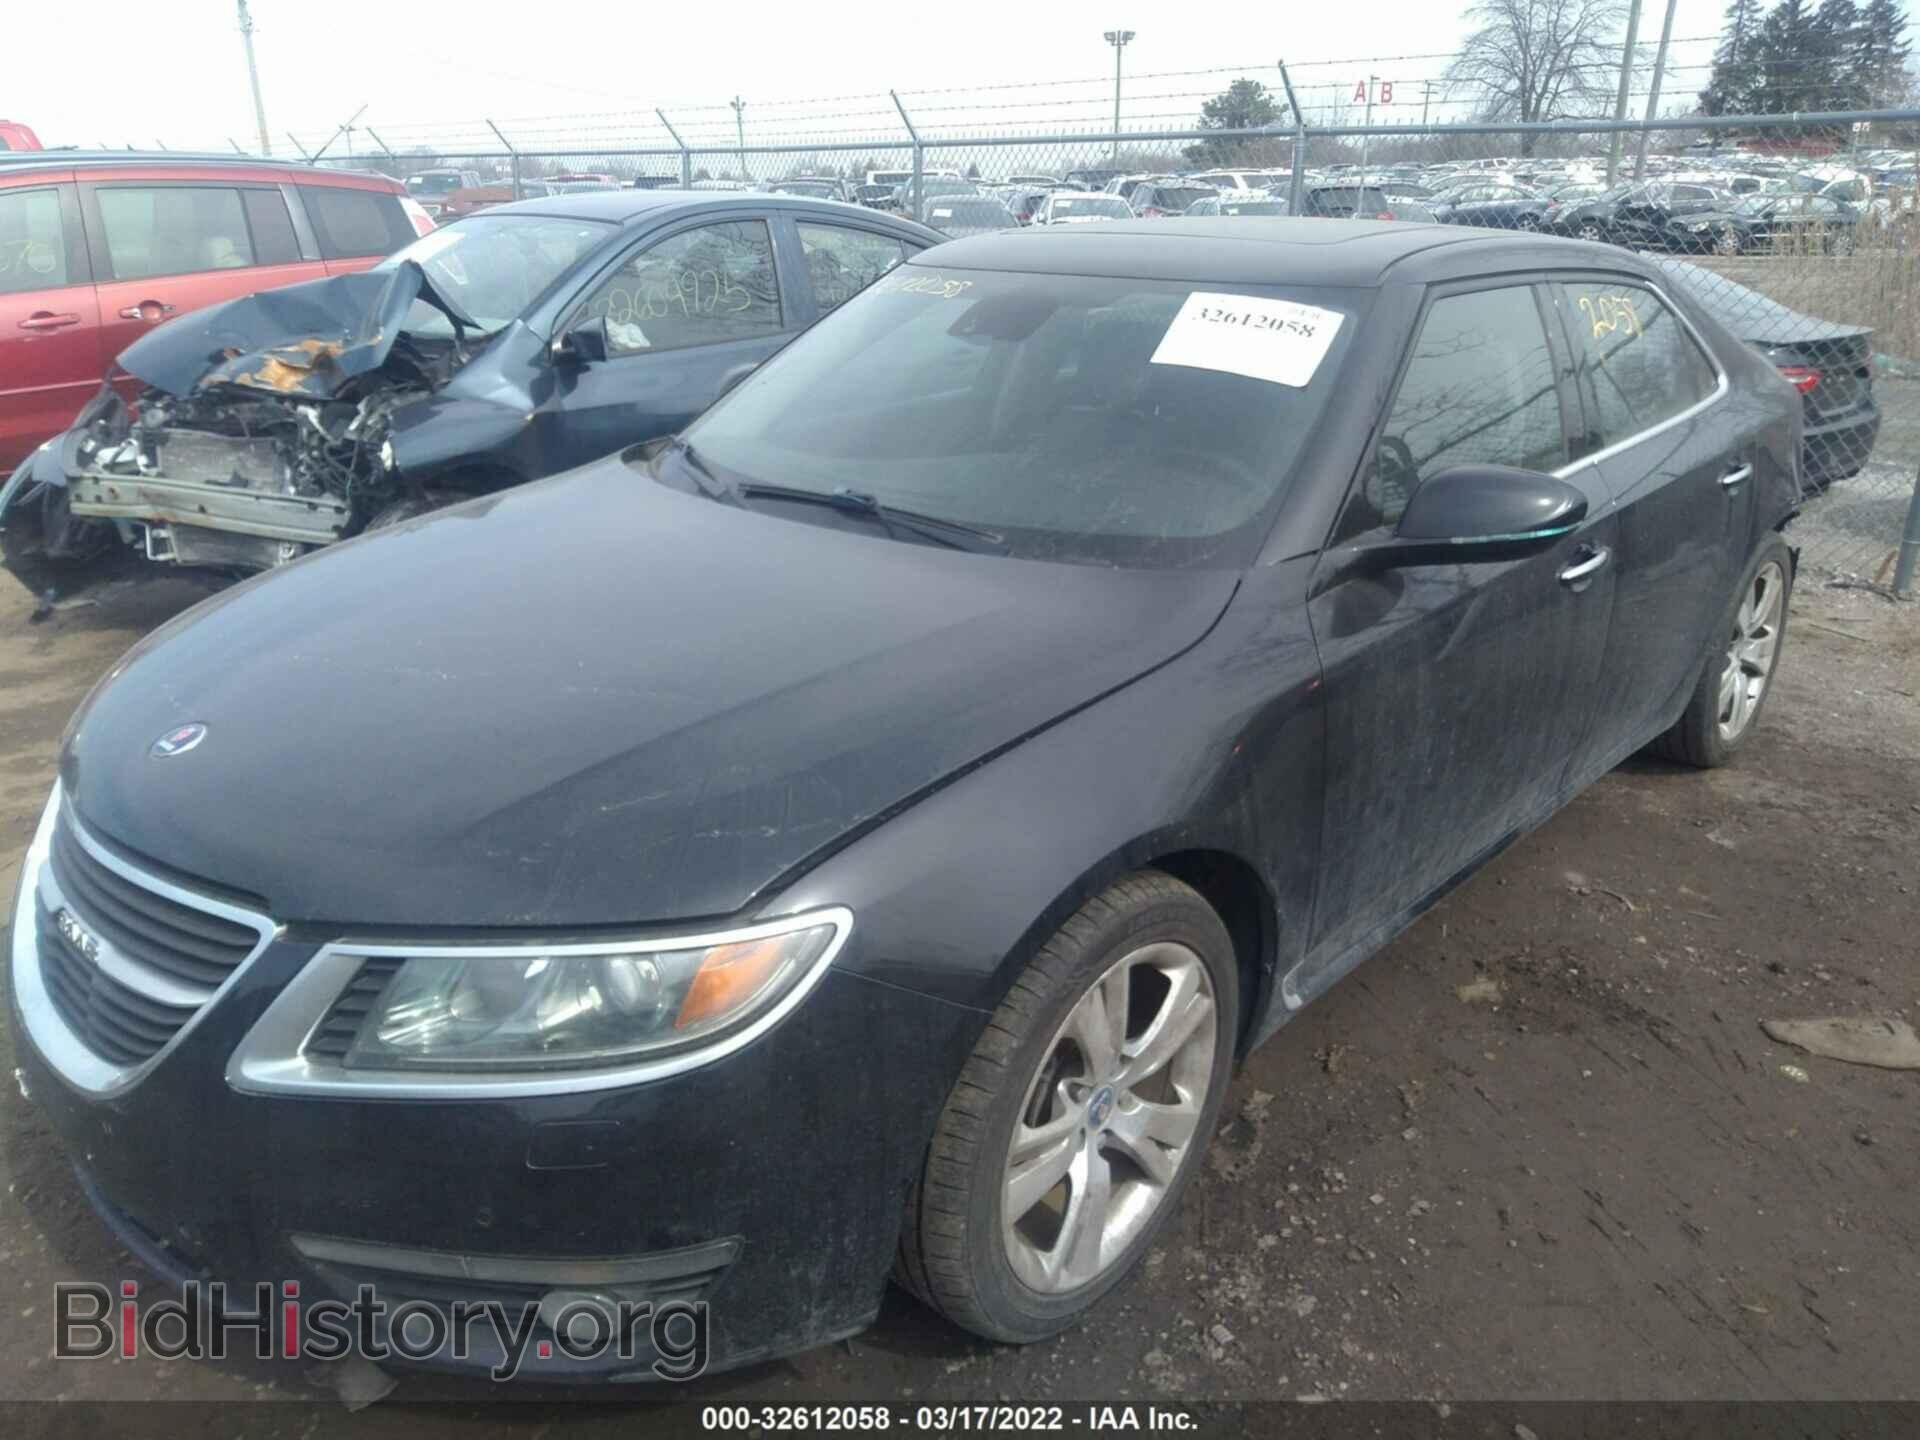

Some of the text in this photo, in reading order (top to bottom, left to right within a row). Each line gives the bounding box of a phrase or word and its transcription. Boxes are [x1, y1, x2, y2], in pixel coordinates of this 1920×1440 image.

[1353, 80, 1393, 104] A B
[1192, 307, 1318, 339] 32612058
